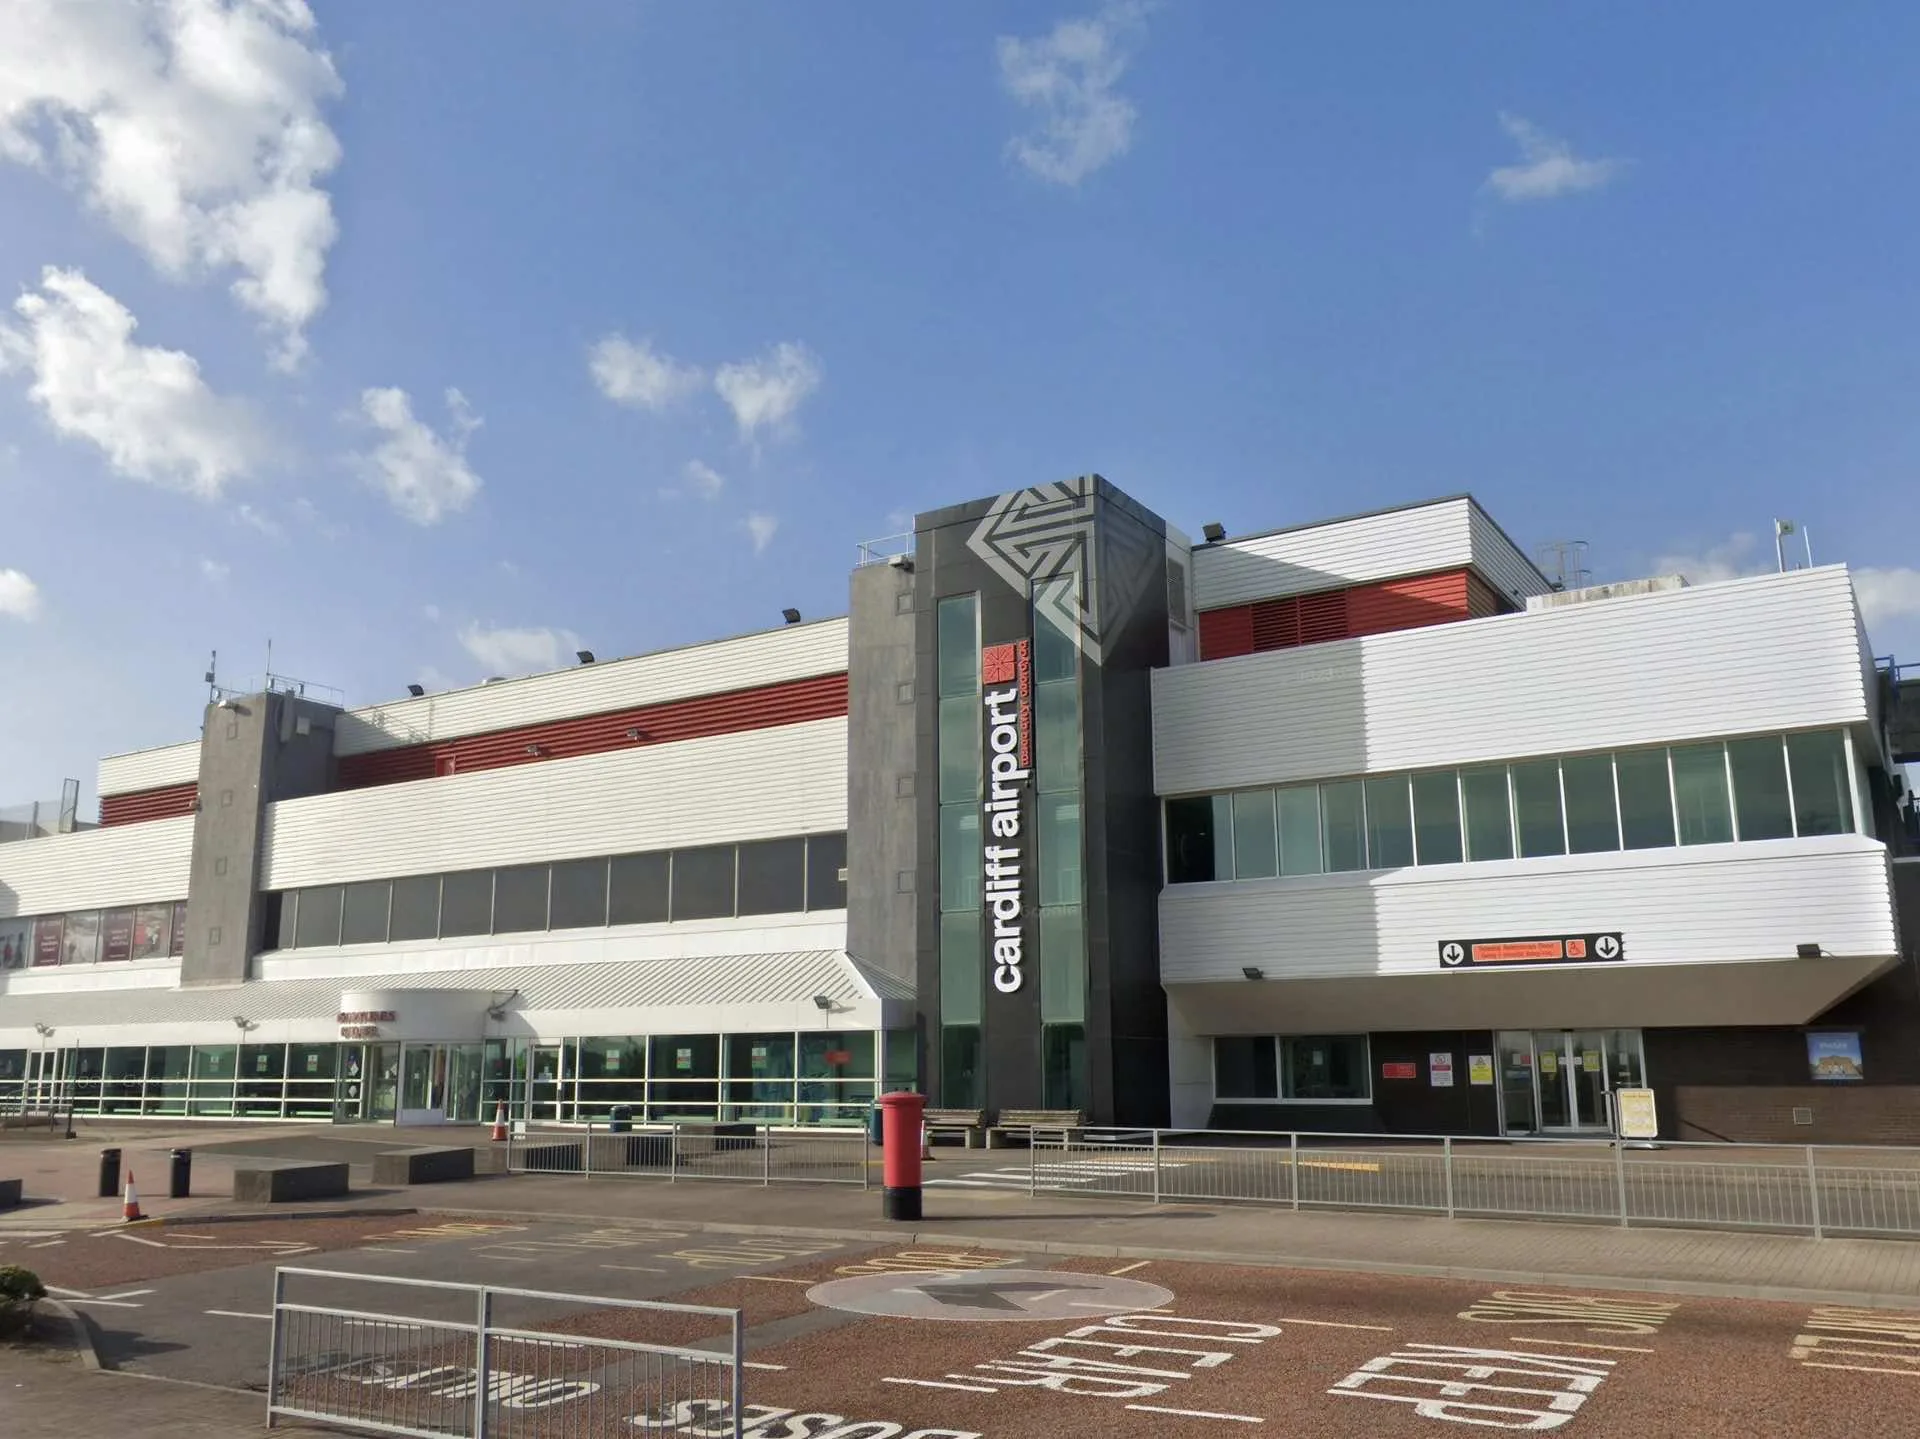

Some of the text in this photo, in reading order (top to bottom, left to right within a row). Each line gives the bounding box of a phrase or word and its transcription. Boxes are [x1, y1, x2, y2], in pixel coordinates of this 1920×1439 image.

[984, 688, 1030, 993] cardiff airport
[945, 1316, 1282, 1397] CLEAR
[1326, 1343, 1618, 1429] KEEP
[624, 1398, 984, 1439] USES
